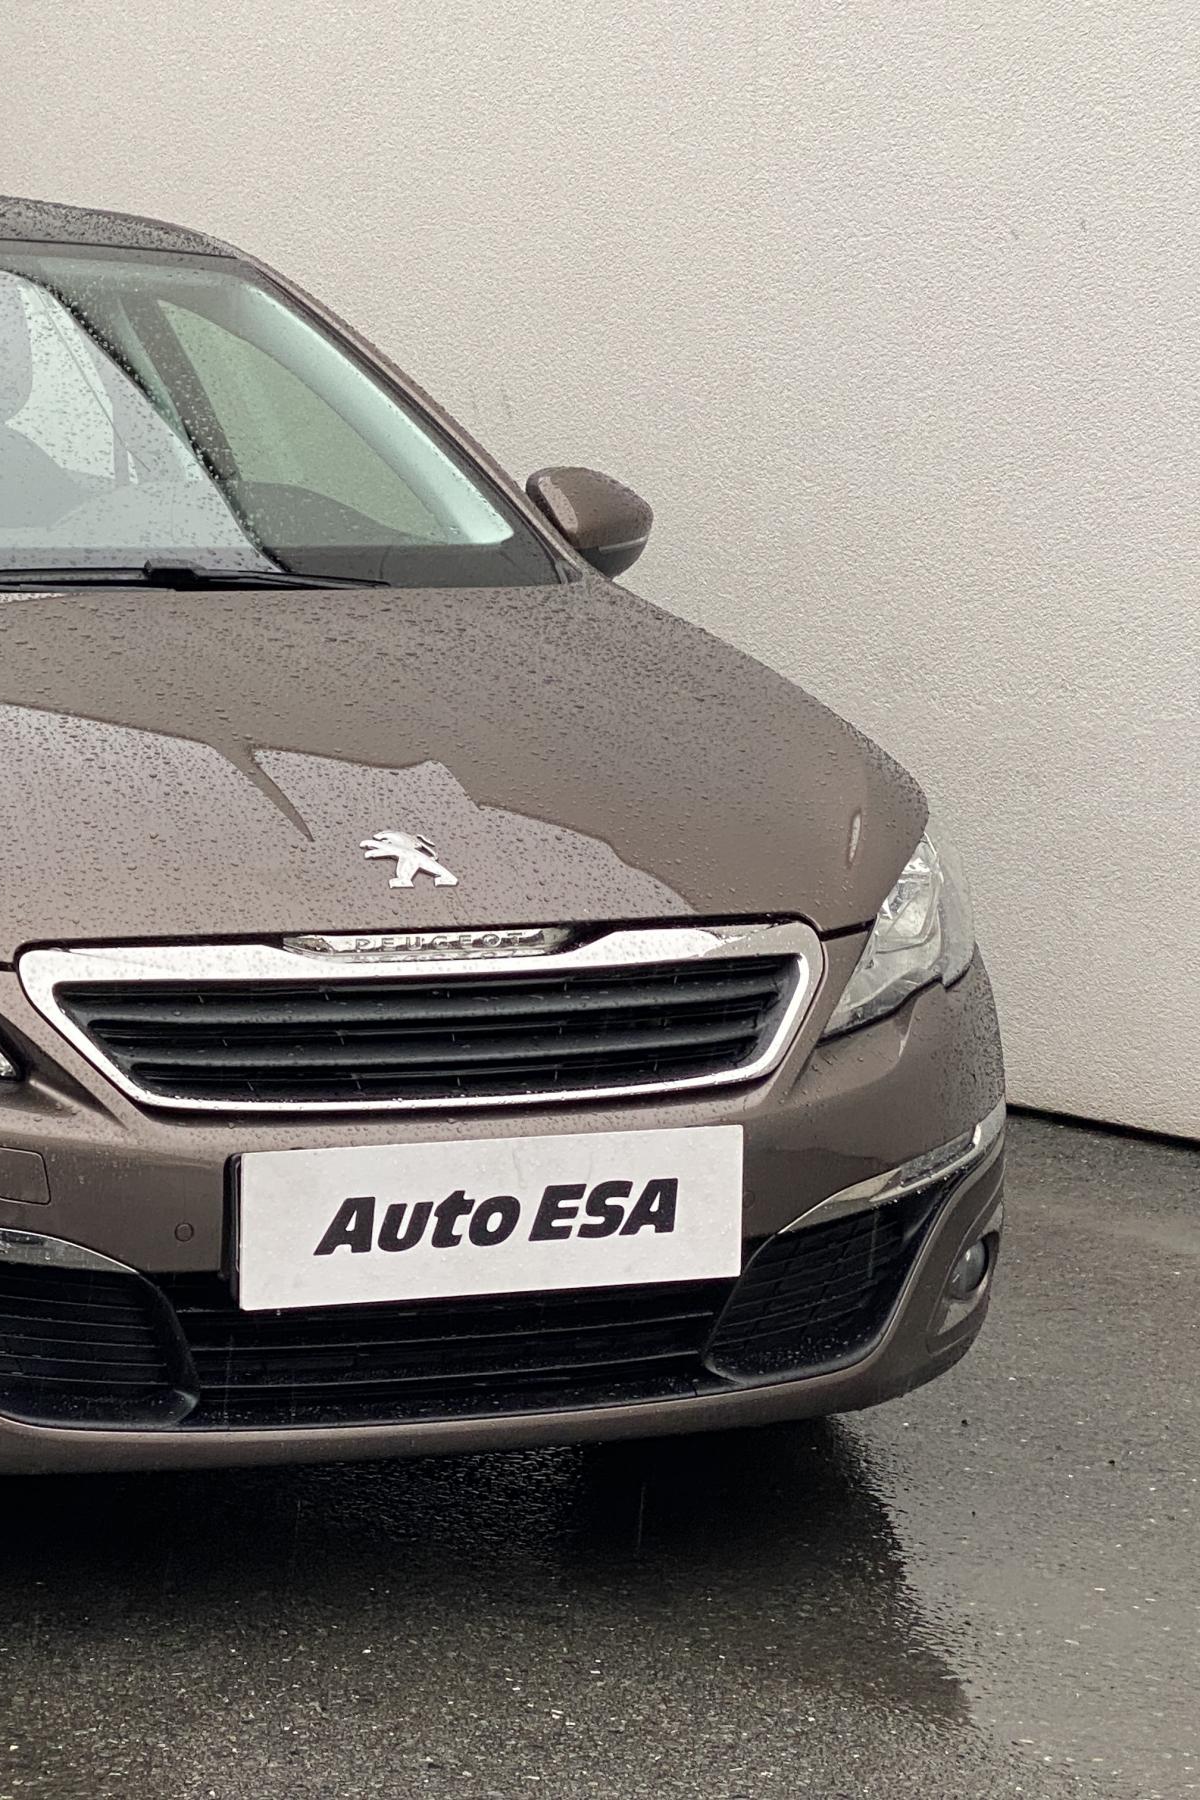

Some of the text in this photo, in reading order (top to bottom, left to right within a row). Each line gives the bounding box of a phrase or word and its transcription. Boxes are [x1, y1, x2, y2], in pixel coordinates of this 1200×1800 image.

[354, 931, 523, 951] PEUGEOT
[313, 1178, 679, 1256] Auto ESA
